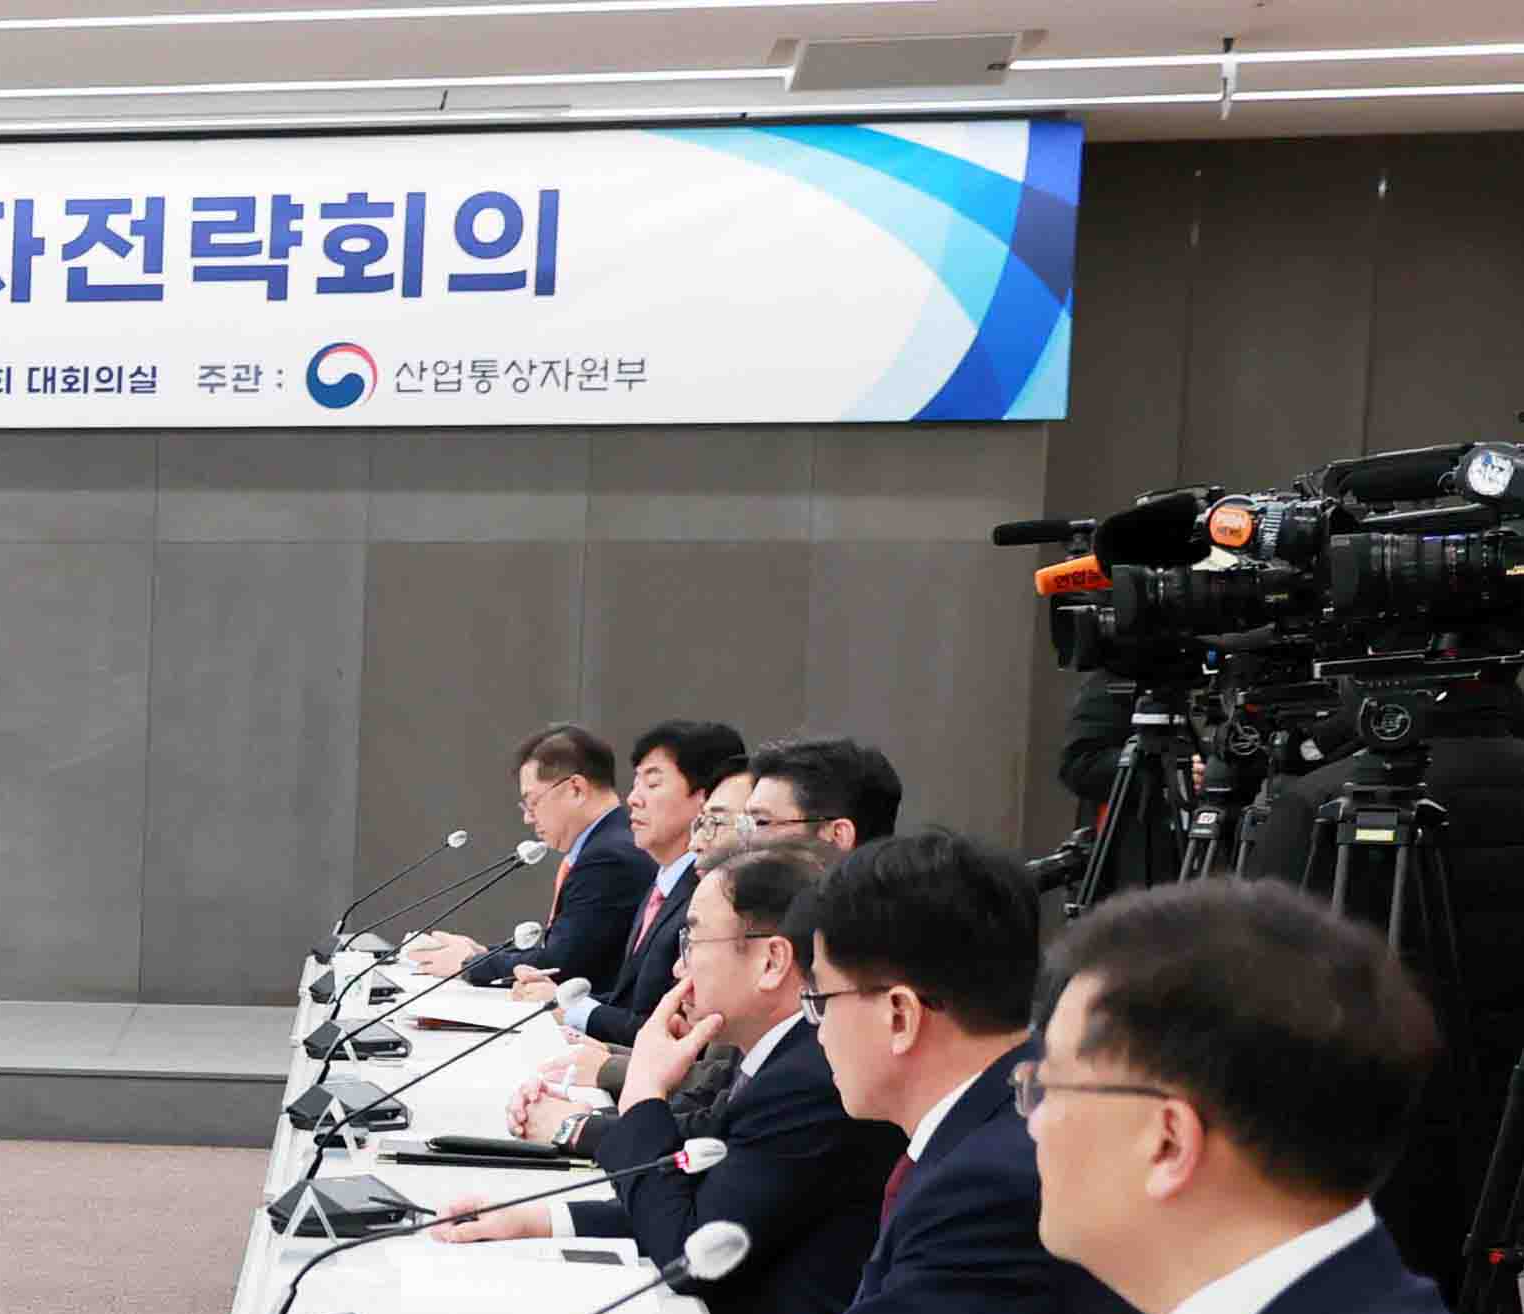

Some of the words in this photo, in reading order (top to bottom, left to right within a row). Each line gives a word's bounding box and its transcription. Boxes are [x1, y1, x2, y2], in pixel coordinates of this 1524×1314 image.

[26, 364, 158, 395] 대회의실
[196, 363, 264, 395] 주관
[394, 357, 648, 395] 산업통상자원부
